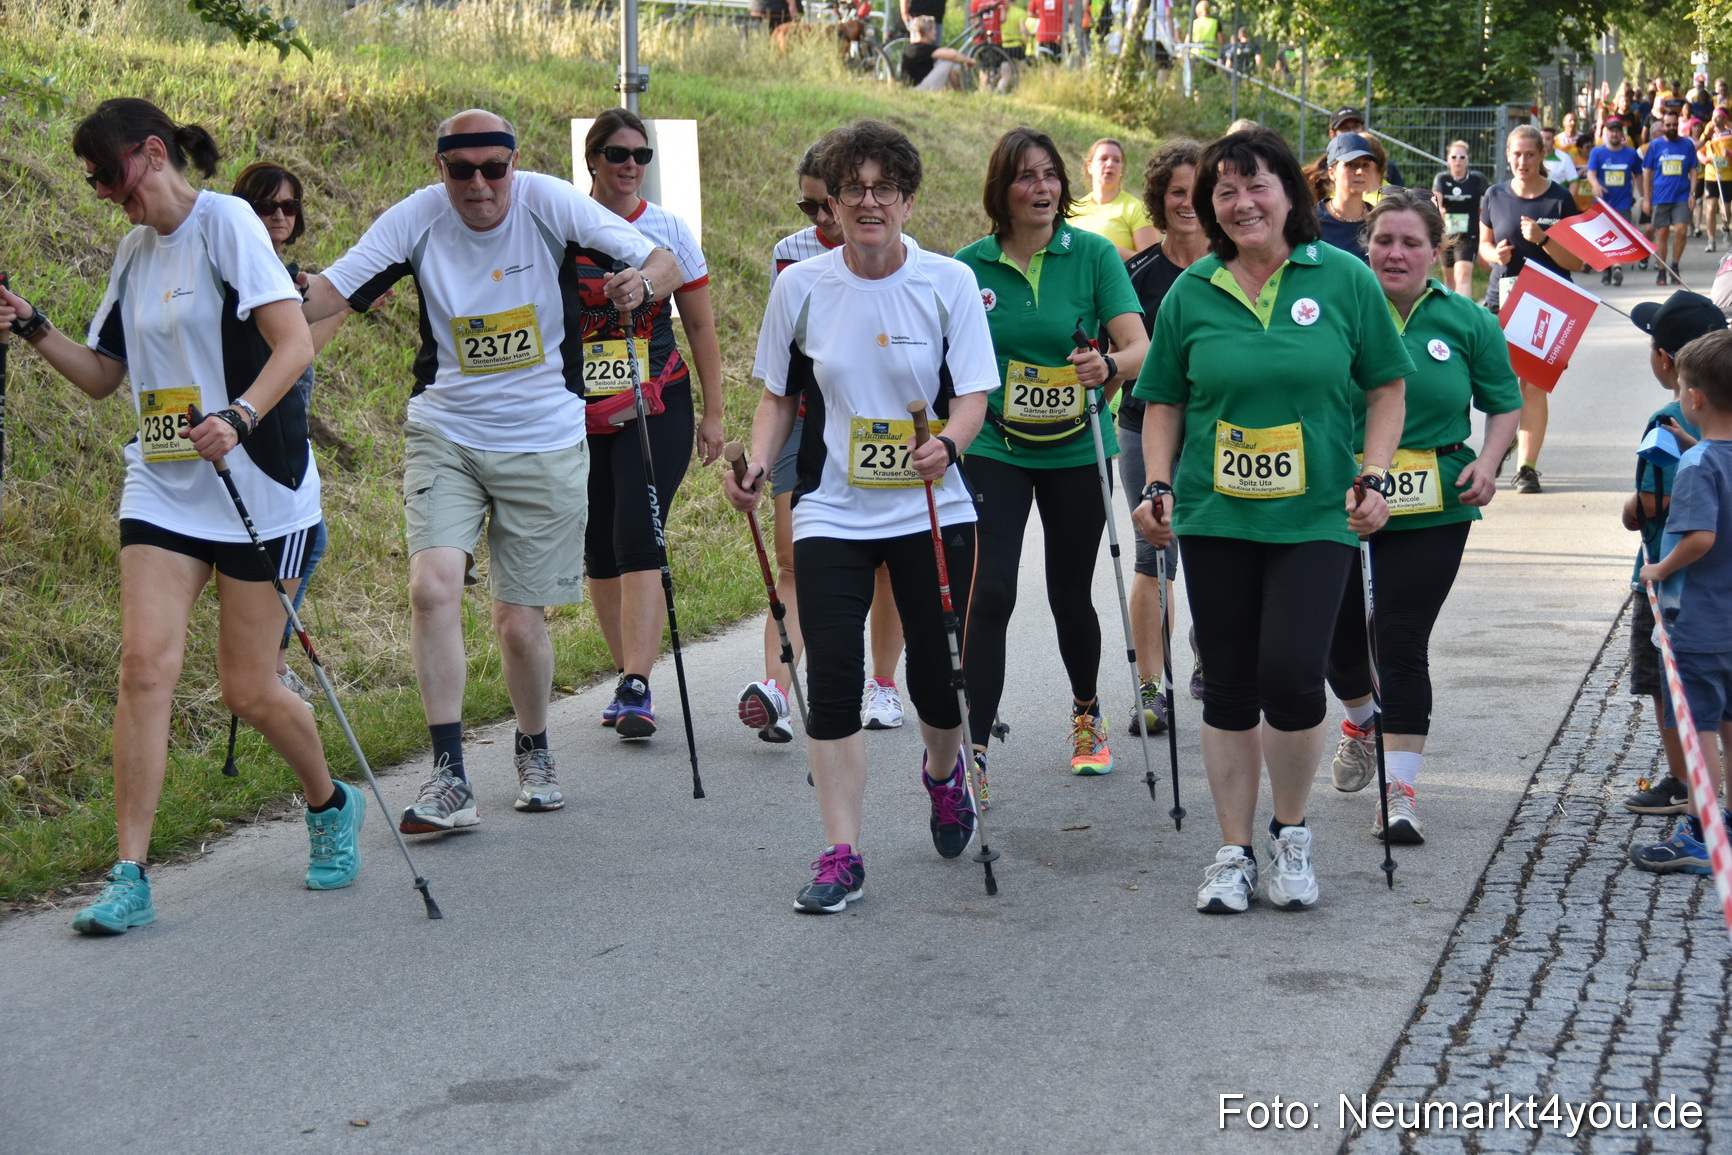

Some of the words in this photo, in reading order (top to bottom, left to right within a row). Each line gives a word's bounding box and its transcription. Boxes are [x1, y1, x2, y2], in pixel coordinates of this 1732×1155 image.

[1537, 318, 1548, 339] DEHN
[465, 329, 531, 358] 2372
[1547, 344, 1562, 365] DEHN
[1560, 318, 1577, 346] protects.
[472, 355, 512, 365] Dintenfelder
[513, 351, 530, 360] Hans
[1014, 384, 1075, 408] 2083
[1049, 407, 1066, 415] Birgit
[151, 442, 168, 450] Schmid
[864, 431, 903, 440] firmenlauf
[860, 444, 912, 469] 237
[1222, 449, 1292, 479] 2086
[1239, 479, 1257, 487] Spitz
[1259, 479, 1272, 487] Uta
[1385, 470, 1428, 497] 087
[243, 516, 266, 551] LEKI
